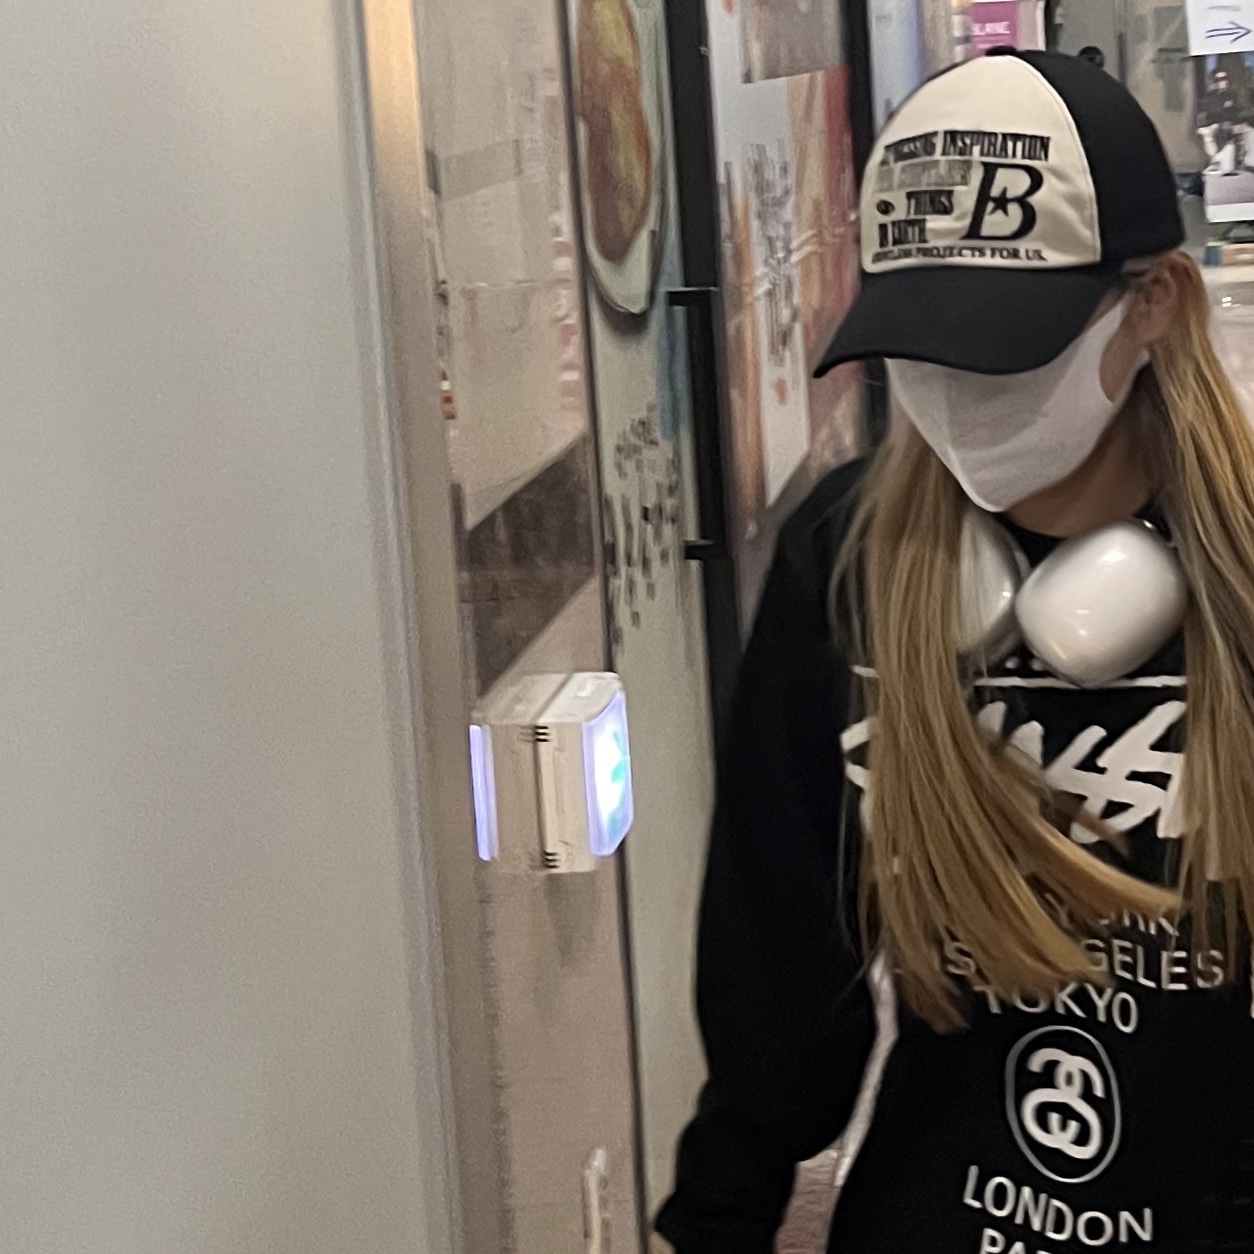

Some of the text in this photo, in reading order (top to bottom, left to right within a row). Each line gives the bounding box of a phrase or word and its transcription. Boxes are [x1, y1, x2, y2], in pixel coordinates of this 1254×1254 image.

[941, 130, 1051, 162] INSPIRATION
[960, 161, 1044, 241] B
[990, 248, 1023, 260] FOR
[1081, 939, 1224, 991] GELES
[963, 1165, 1153, 1246] LONDON
